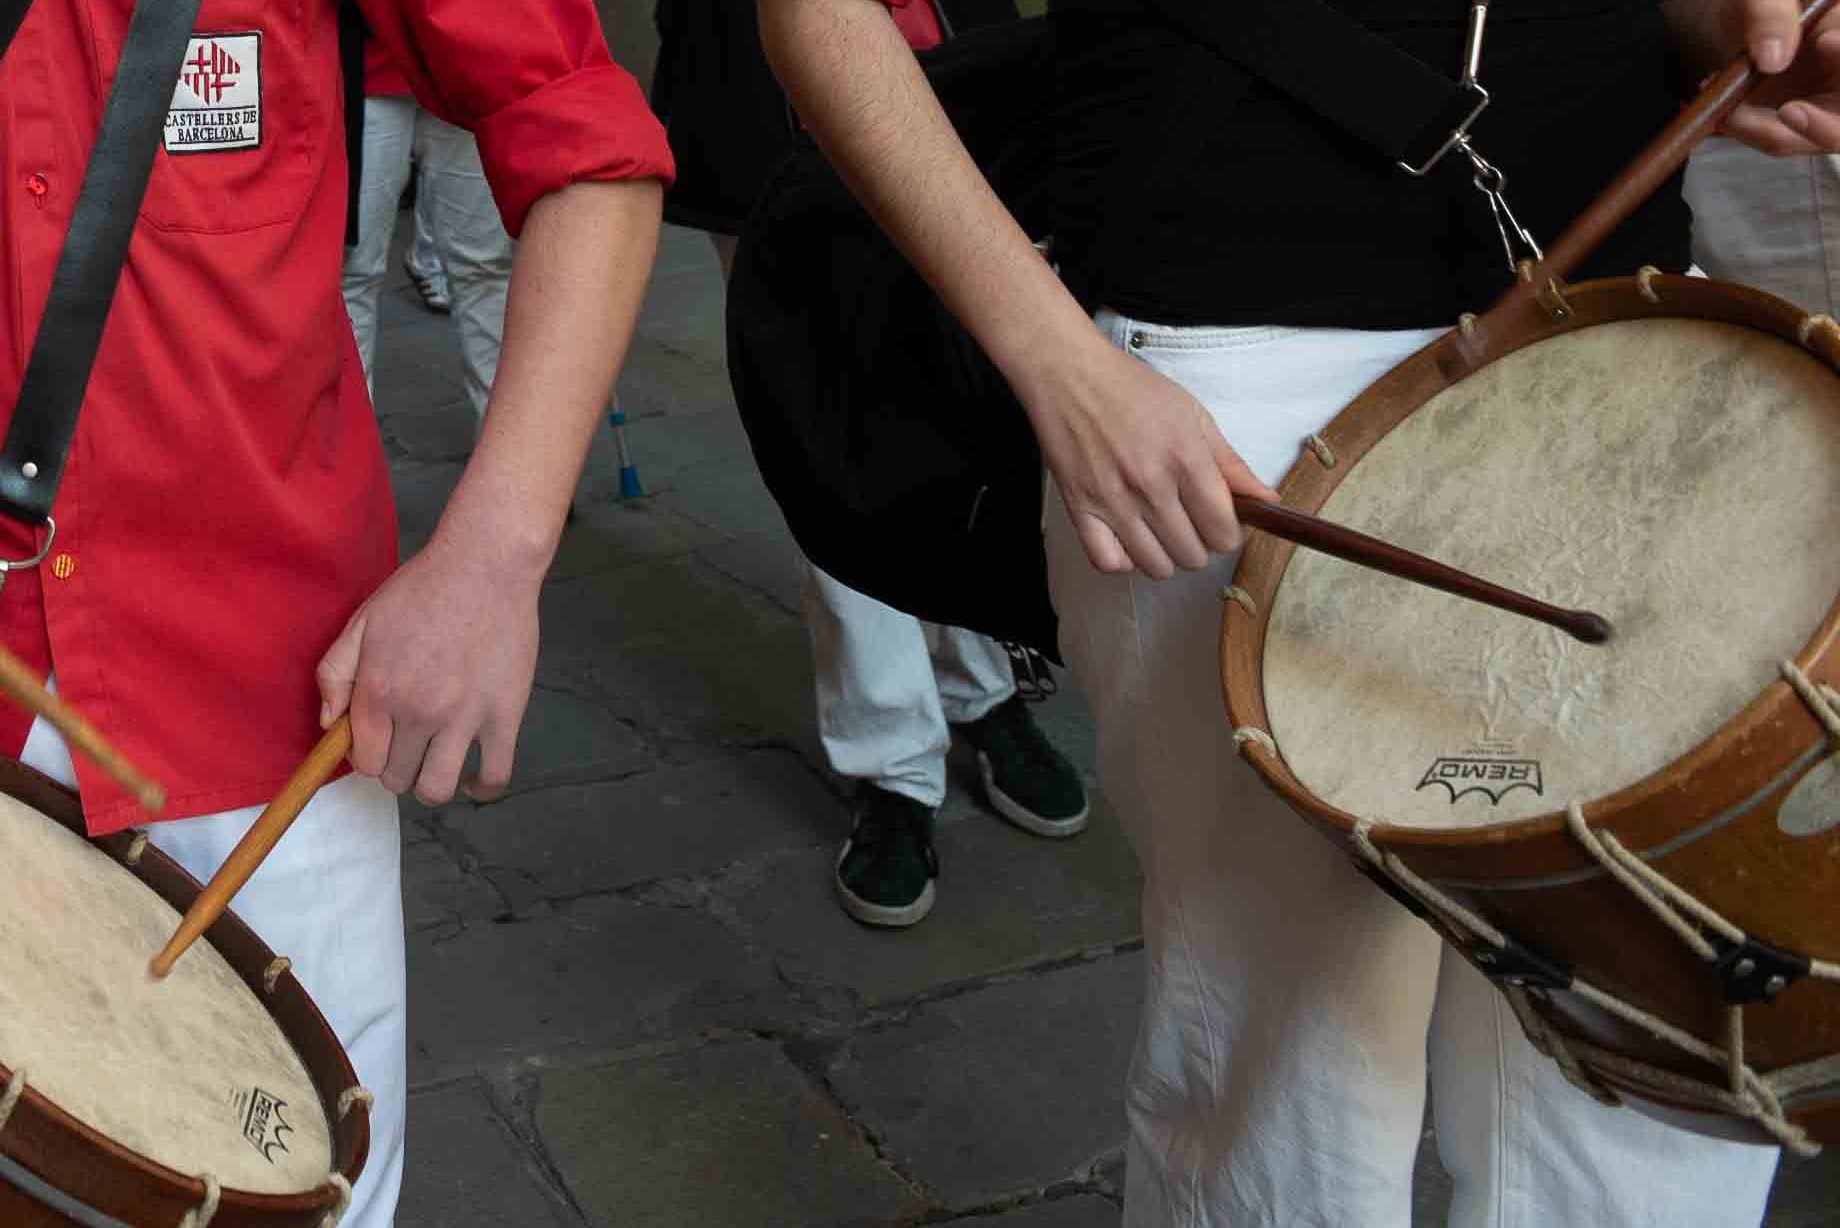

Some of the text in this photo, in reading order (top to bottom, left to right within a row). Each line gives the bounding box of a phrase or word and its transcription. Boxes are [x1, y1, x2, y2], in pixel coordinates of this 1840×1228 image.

[164, 110, 257, 128] CASTELLERS DE
[178, 126, 244, 142] BARCELONA
[1439, 763, 1530, 781] REMO
[249, 1096, 273, 1144] REMO
